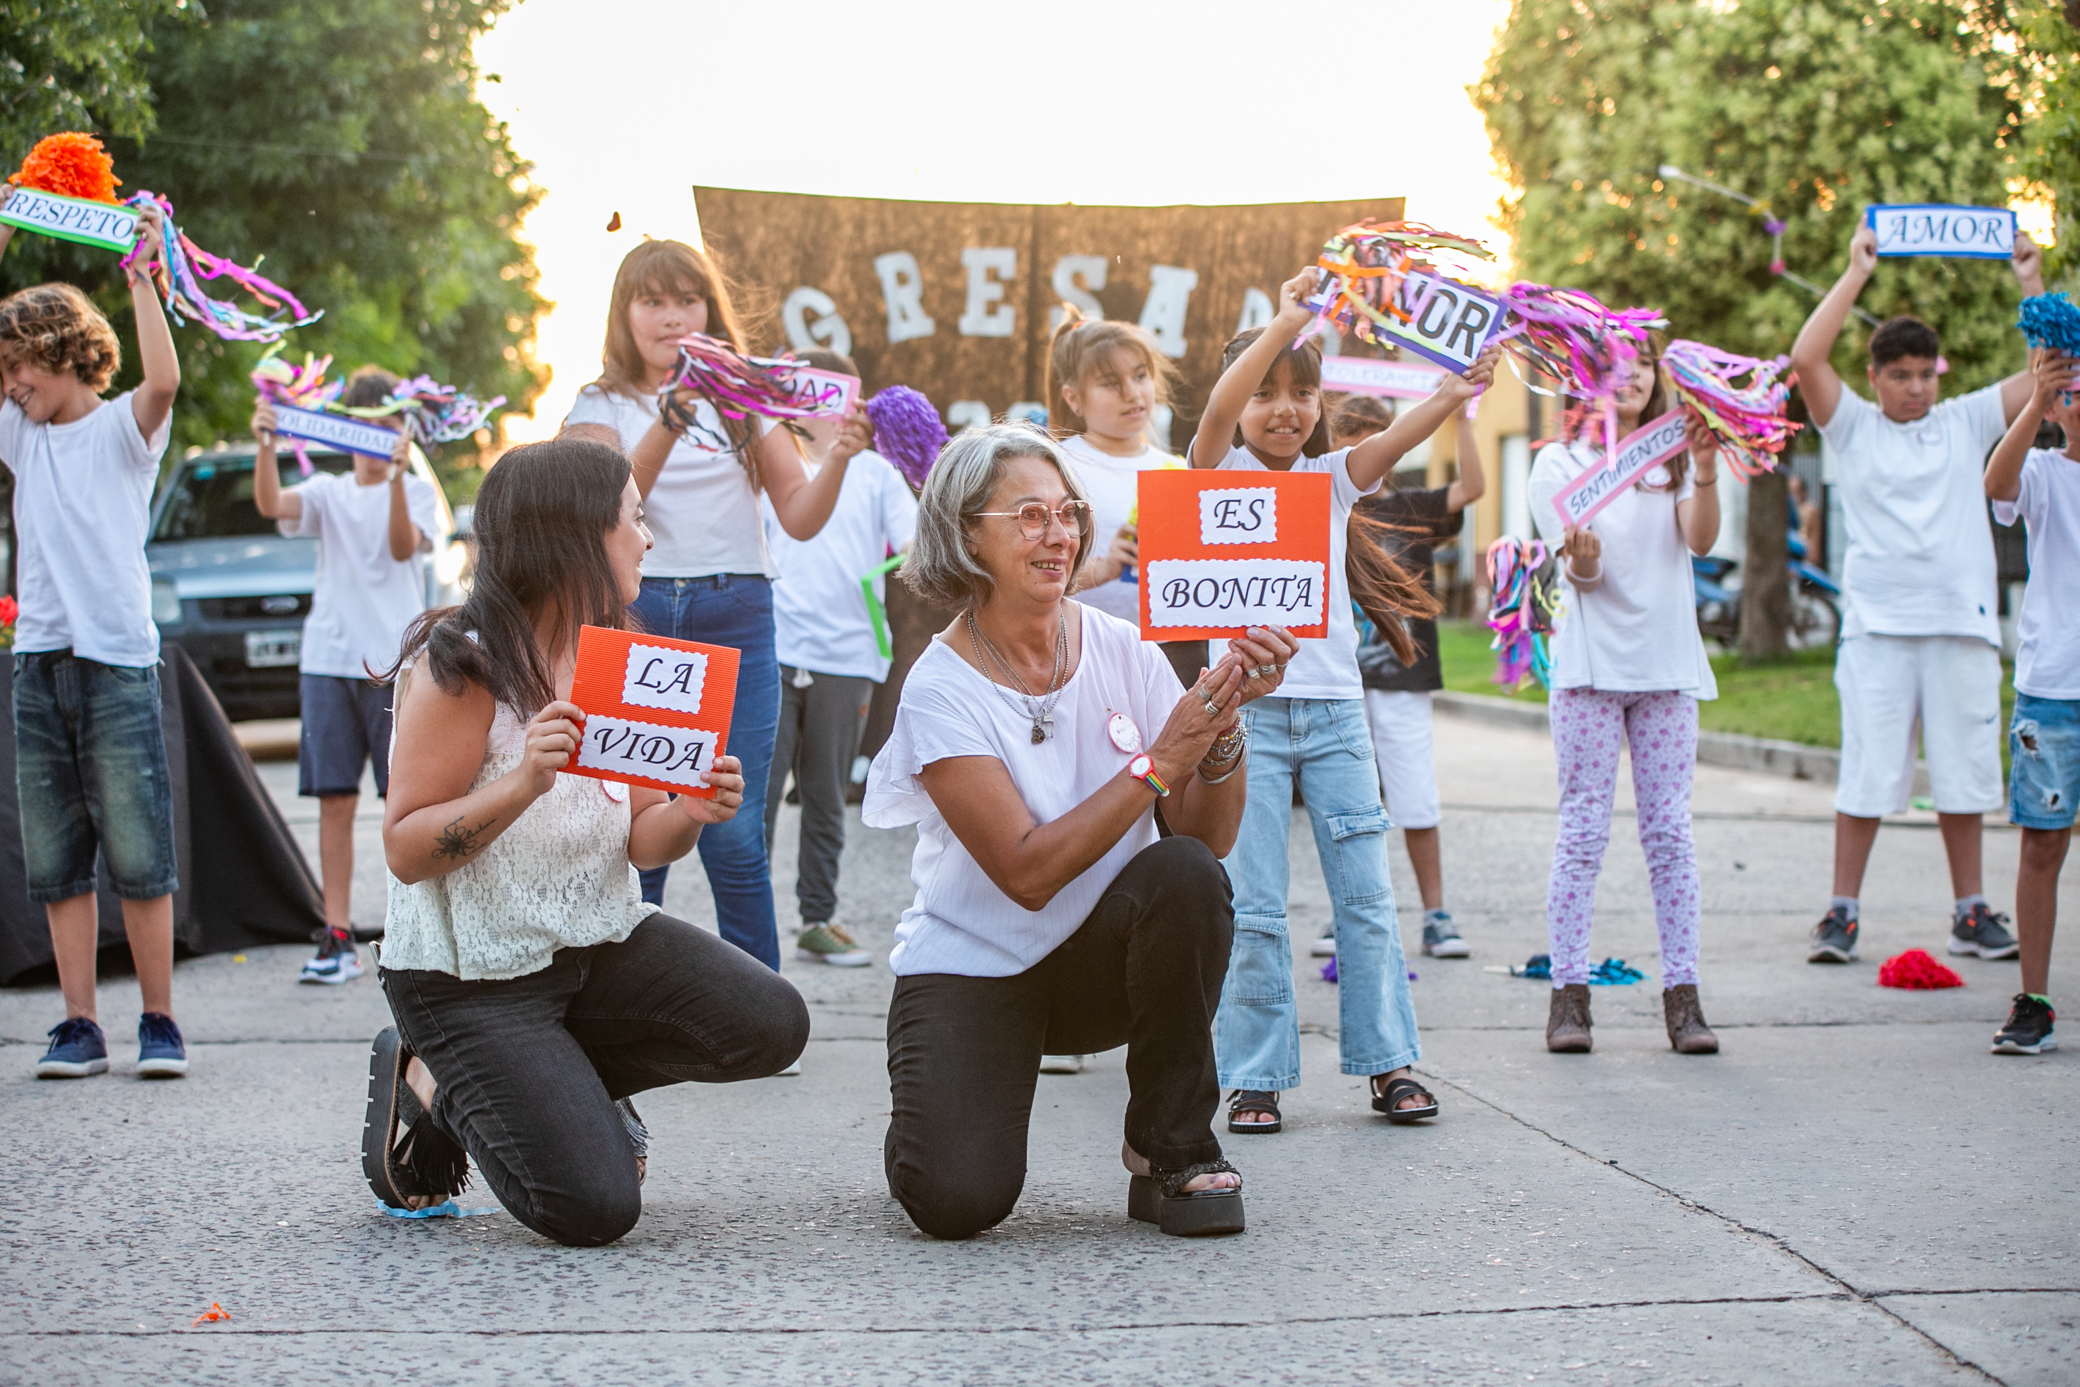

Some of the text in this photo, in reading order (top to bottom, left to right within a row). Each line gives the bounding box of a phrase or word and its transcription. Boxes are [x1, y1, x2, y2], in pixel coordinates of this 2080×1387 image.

[6, 193, 134, 239] RESPETO
[1877, 214, 2013, 250] AMOR
[1570, 418, 1686, 515] SENTIMIENTOS
[1214, 499, 1265, 531] ES
[1162, 575, 1312, 612] BONITA
[634, 658, 694, 695] LA
[594, 727, 704, 771] VIDA
